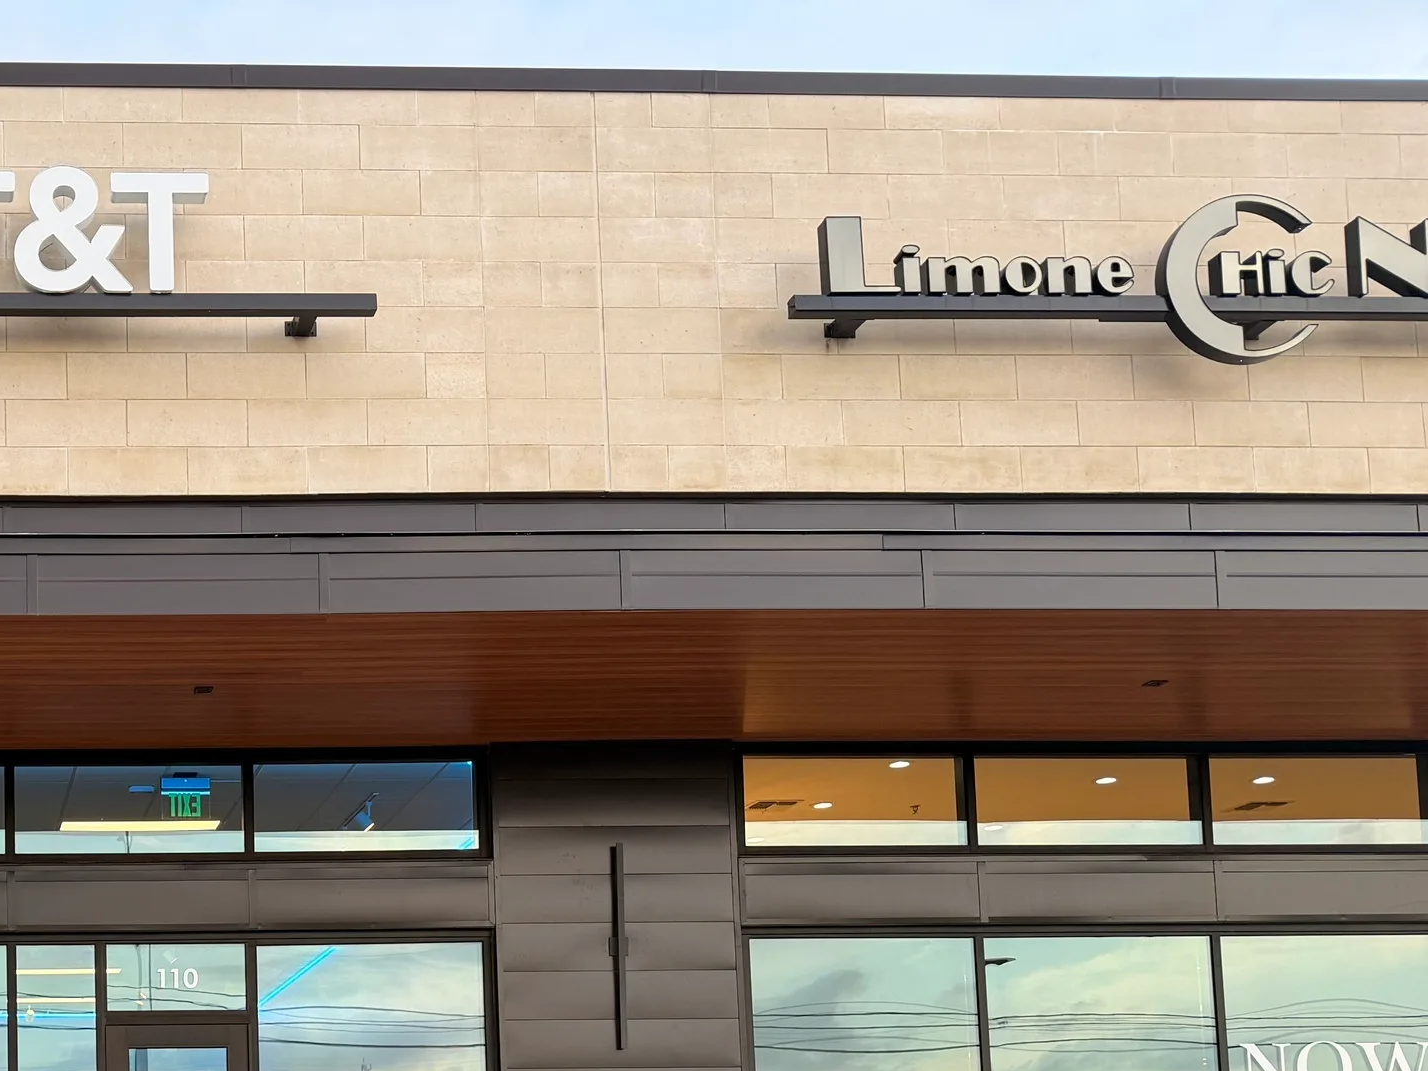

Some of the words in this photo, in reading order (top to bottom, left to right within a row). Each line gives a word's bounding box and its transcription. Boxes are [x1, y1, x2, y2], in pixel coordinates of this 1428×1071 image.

[818, 215, 1135, 296] Limone
[1155, 194, 1335, 365] Chic
[156, 968, 199, 989] 110
